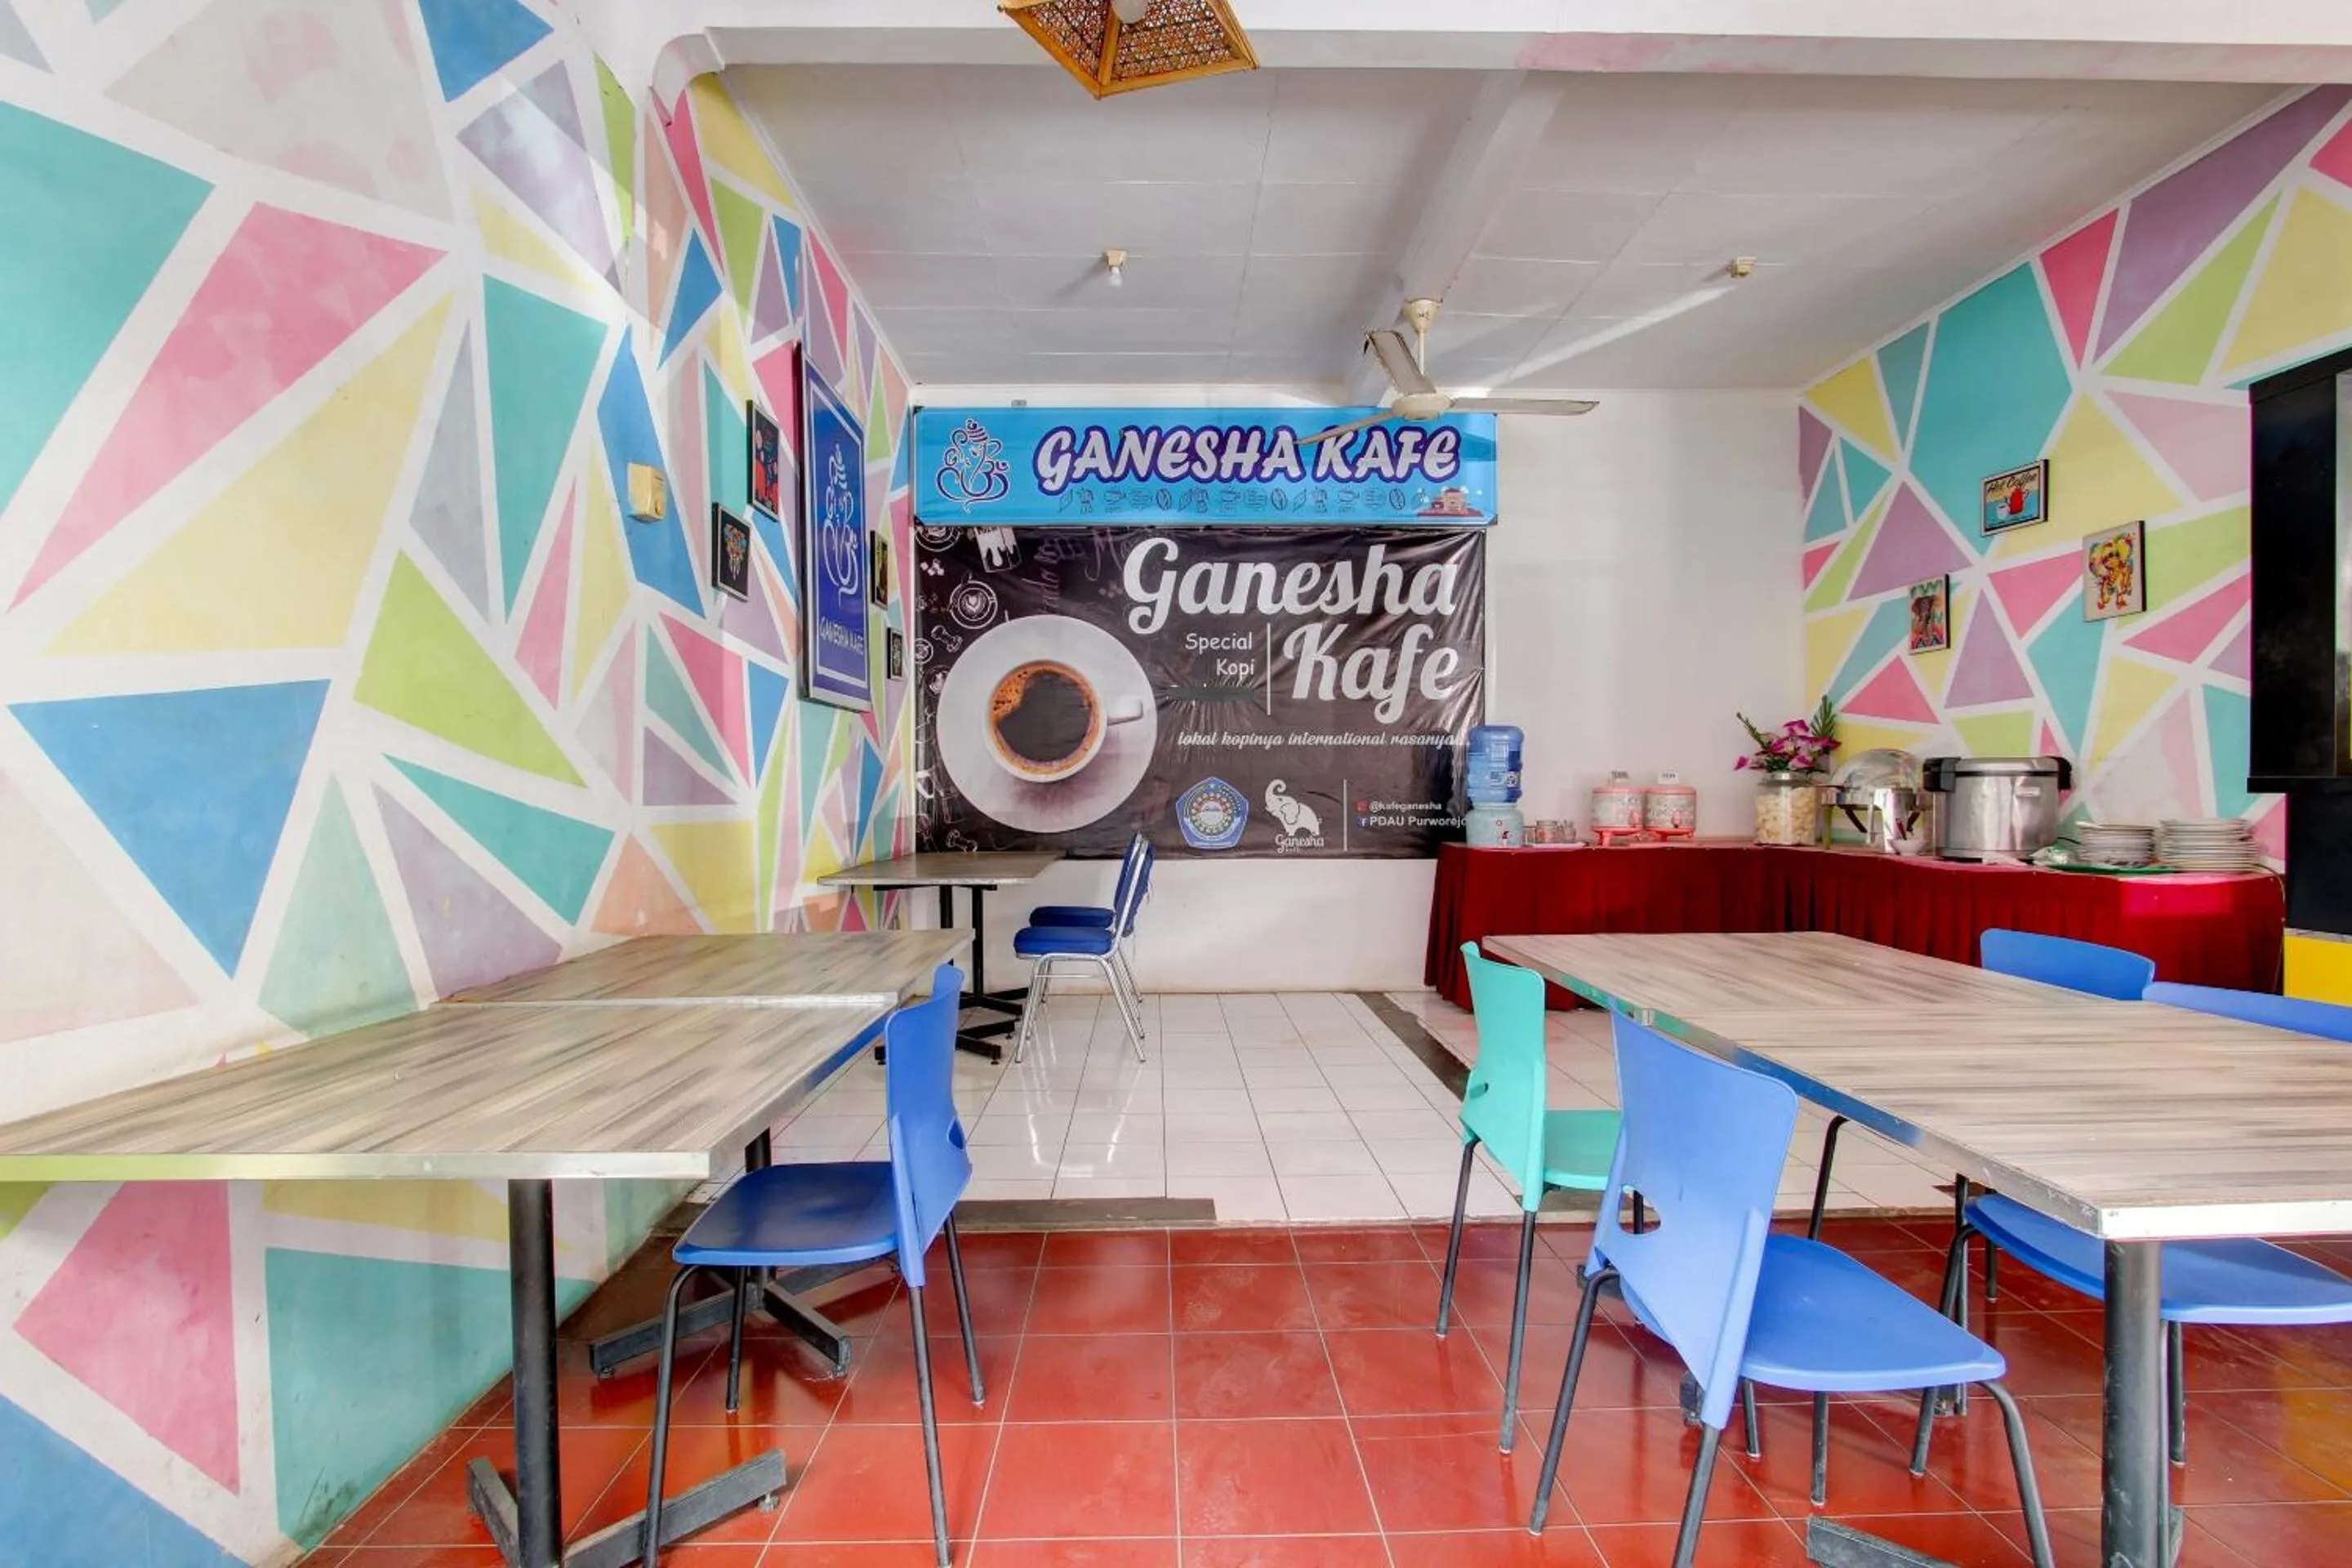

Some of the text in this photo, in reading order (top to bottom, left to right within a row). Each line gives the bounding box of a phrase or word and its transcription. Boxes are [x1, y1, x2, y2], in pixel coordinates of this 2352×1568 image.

[1032, 425, 1461, 495] GANESHA KAFE
[1123, 537, 1459, 635] Ganesha
[1185, 632, 1253, 654] Special
[1216, 658, 1255, 679] Kopi
[1282, 623, 1459, 724] Kafe
[1221, 732, 1284, 750] kopinya
[1288, 732, 1387, 746] international
[1370, 816, 1405, 826] PDAU
[1408, 816, 1468, 828] Purworejo
[1275, 833, 1325, 853] Ganesha
